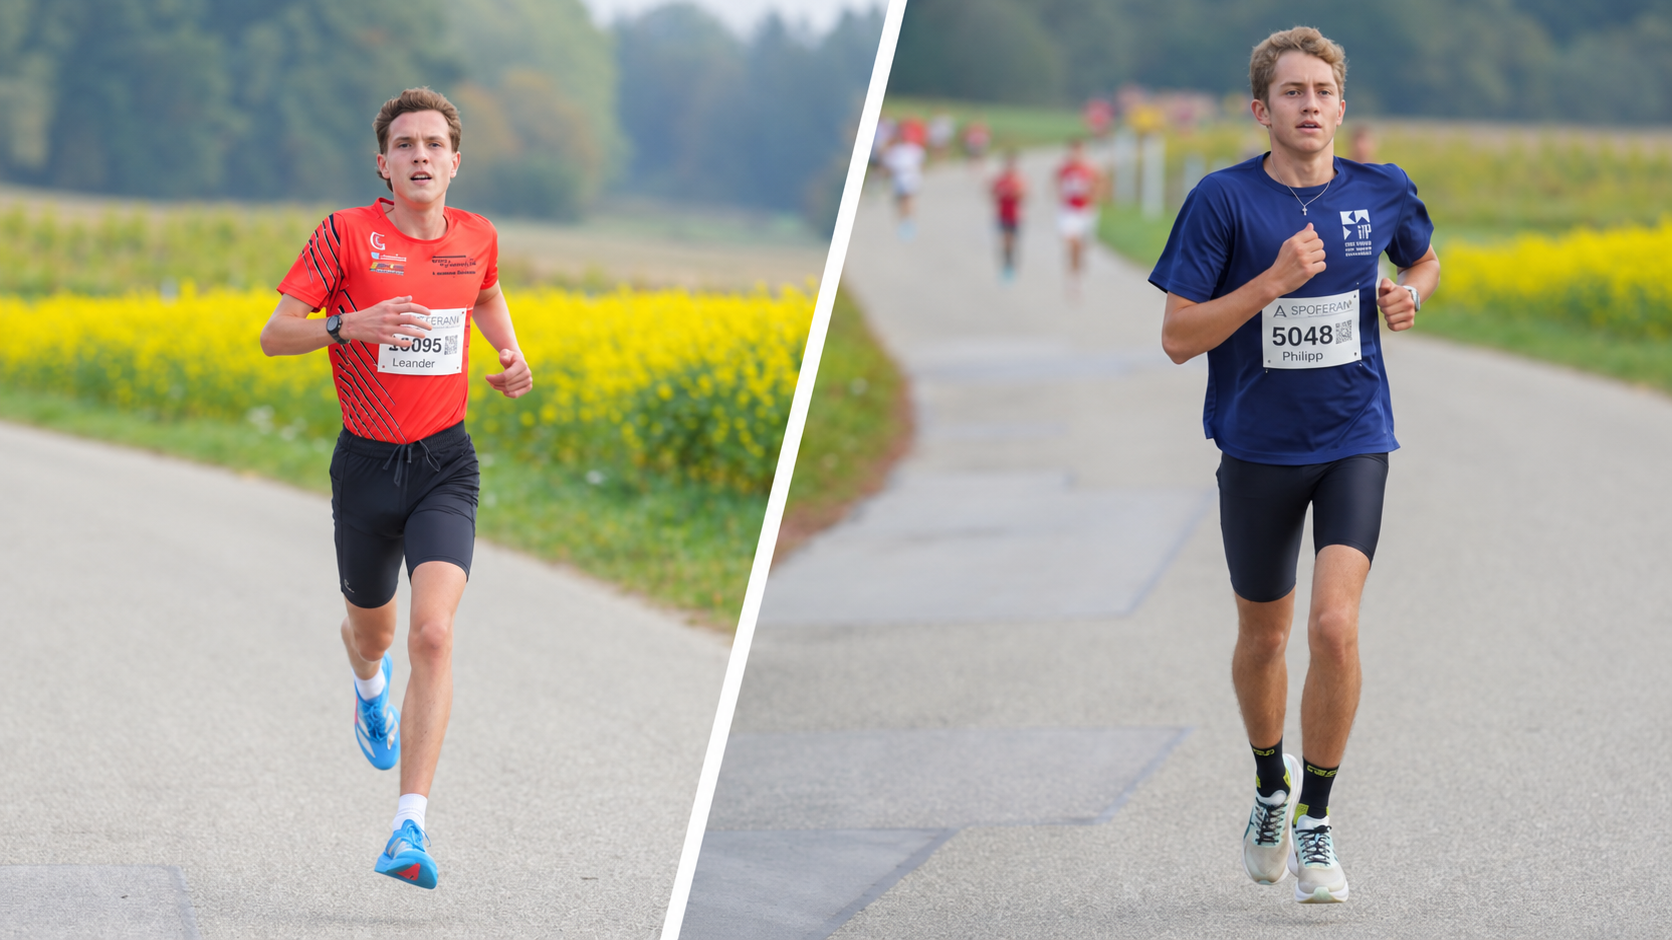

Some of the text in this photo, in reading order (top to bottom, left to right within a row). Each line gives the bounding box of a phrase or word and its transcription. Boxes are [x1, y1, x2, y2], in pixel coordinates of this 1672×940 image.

[1272, 325, 1333, 347] 5048
[392, 358, 435, 368] Leander
[1282, 351, 1324, 363] Philipp
